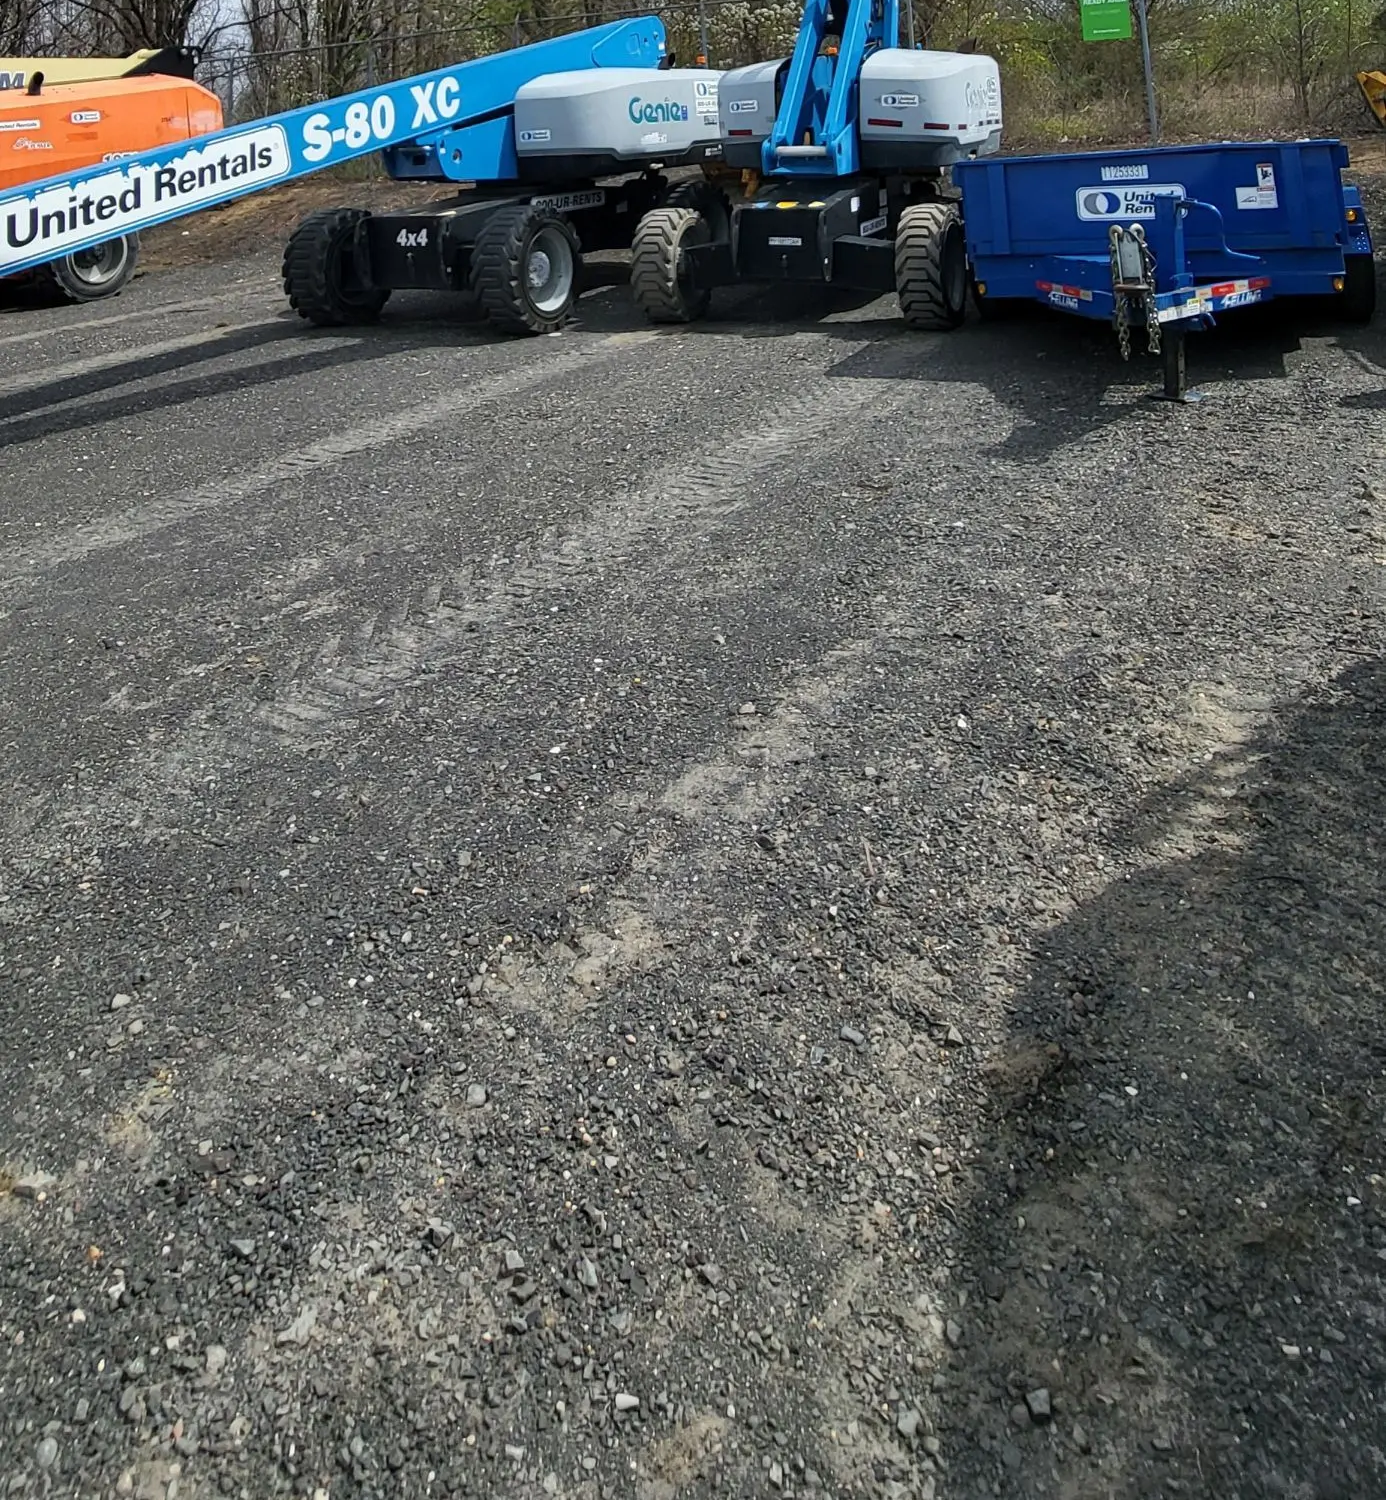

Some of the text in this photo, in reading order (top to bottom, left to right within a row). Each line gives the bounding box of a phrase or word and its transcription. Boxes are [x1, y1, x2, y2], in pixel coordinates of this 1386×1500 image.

[301, 76, 461, 162] S-80 XC
[628, 96, 681, 124] Genie
[6, 141, 273, 248] United Rentals
[396, 228, 429, 247] 4x4
